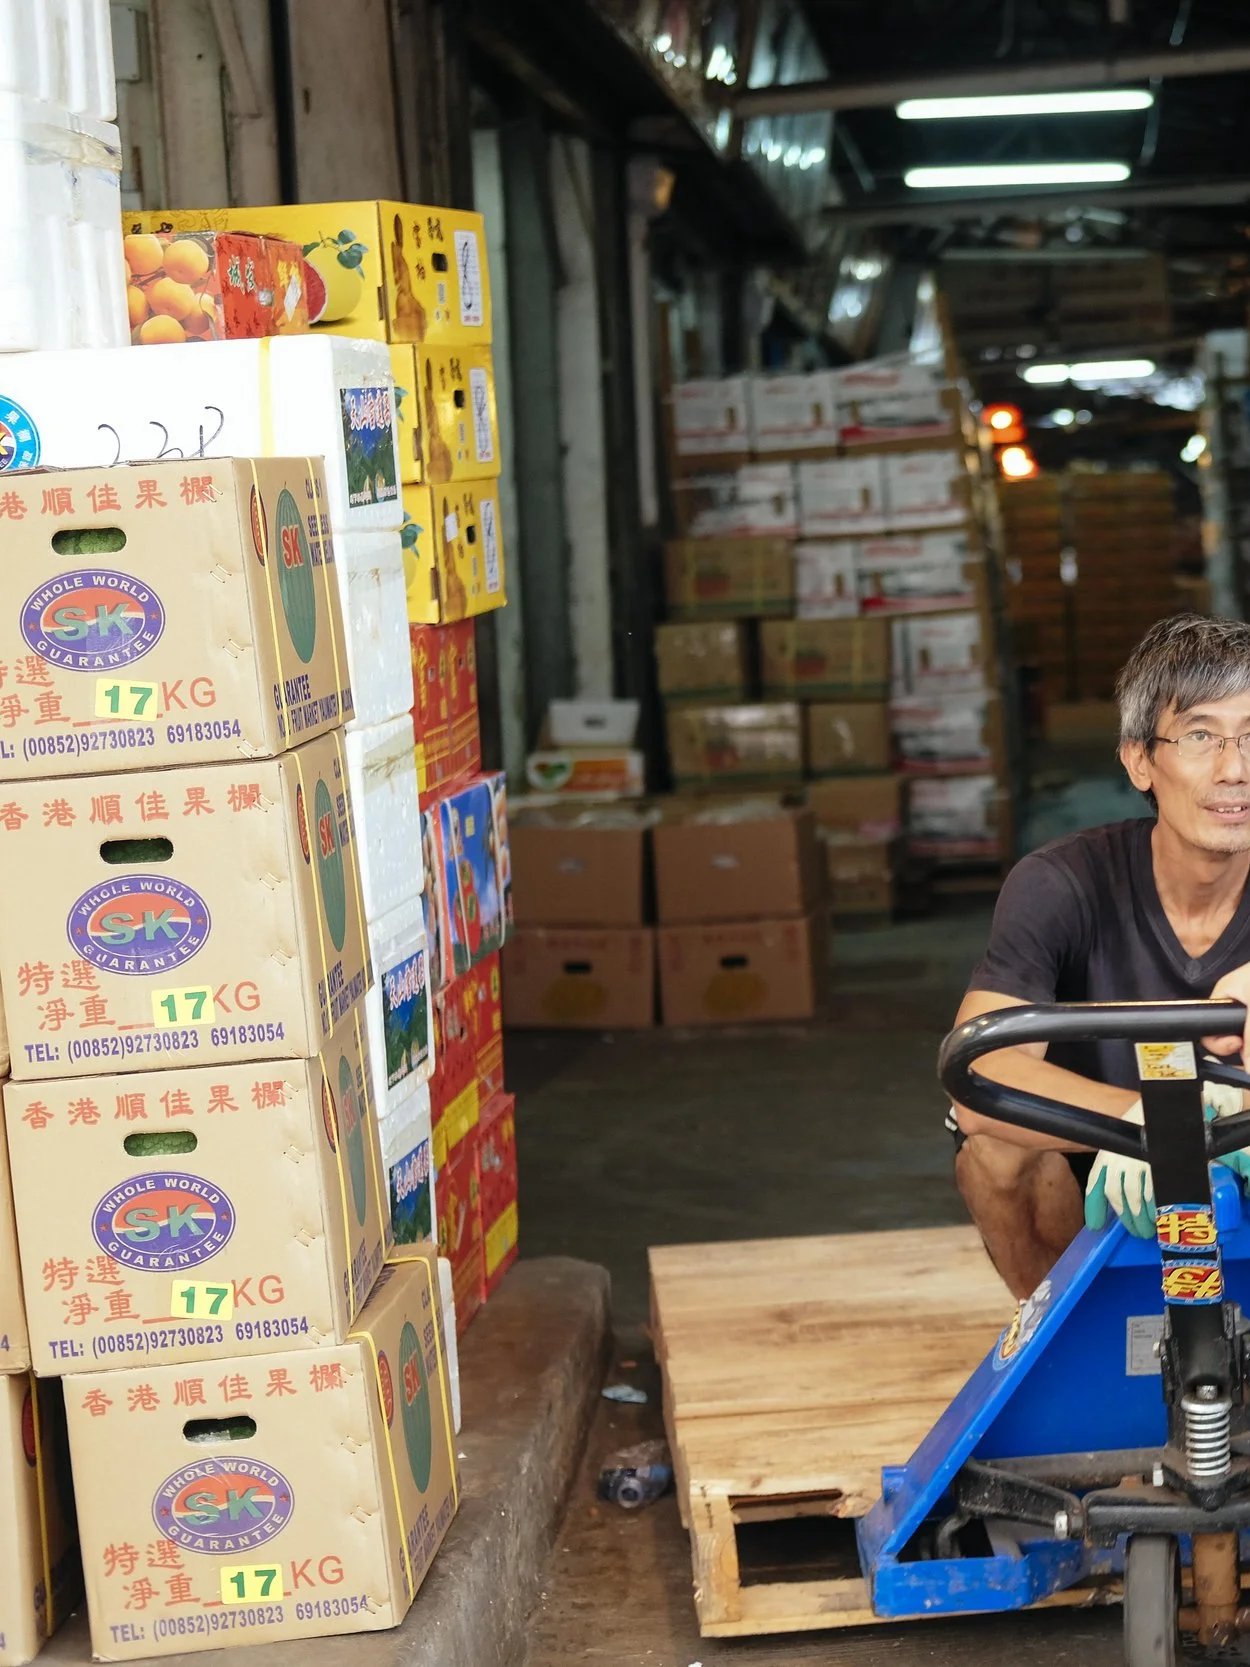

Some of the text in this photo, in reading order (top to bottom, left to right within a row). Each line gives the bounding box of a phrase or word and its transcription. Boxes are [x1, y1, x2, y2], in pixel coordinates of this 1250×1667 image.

[280, 525, 304, 567] SK
[31, 575, 149, 612] WHOLE WORLD
[52, 603, 134, 641] SK
[36, 631, 154, 666] GUARANTEE
[0, 655, 55, 688] 選
[105, 685, 152, 715] 17
[161, 677, 216, 711] KG
[23, 727, 155, 761] (00852)92730823
[167, 719, 241, 743] 69183054
[0, 783, 261, 831] 香港順佳果欄
[319, 813, 336, 857] SK
[77, 881, 195, 917] WHOLE WORLD
[100, 908, 179, 945] SK
[83, 936, 199, 970] GUARANTEE
[17, 959, 100, 997] 特選
[160, 991, 207, 1022] 17
[213, 981, 260, 1014] KG
[24, 1022, 285, 1063] TEL: (00852)92730823 69183054
[21, 1080, 287, 1130] 香港順佳果欄
[102, 1178, 220, 1213] WHOLE WORLD
[123, 1203, 205, 1242] SK
[108, 1231, 224, 1267] GUARANTEE
[42, 1255, 125, 1292] 特選
[180, 1286, 229, 1315] 17
[231, 1274, 285, 1308] KG
[49, 1316, 308, 1360] TEL: (00852)92730823 69183054
[81, 1363, 344, 1417] 香港順佳果欄
[402, 1351, 421, 1406] SK
[162, 1462, 279, 1499] WHOLE WORLD
[183, 1486, 264, 1526] SK
[168, 1513, 284, 1550] GUARANTEE
[103, 1539, 185, 1578] 特選
[230, 1569, 277, 1598] 17
[290, 1555, 344, 1590] KG
[110, 1594, 368, 1643] TEL: (00852)92730823 69183054
